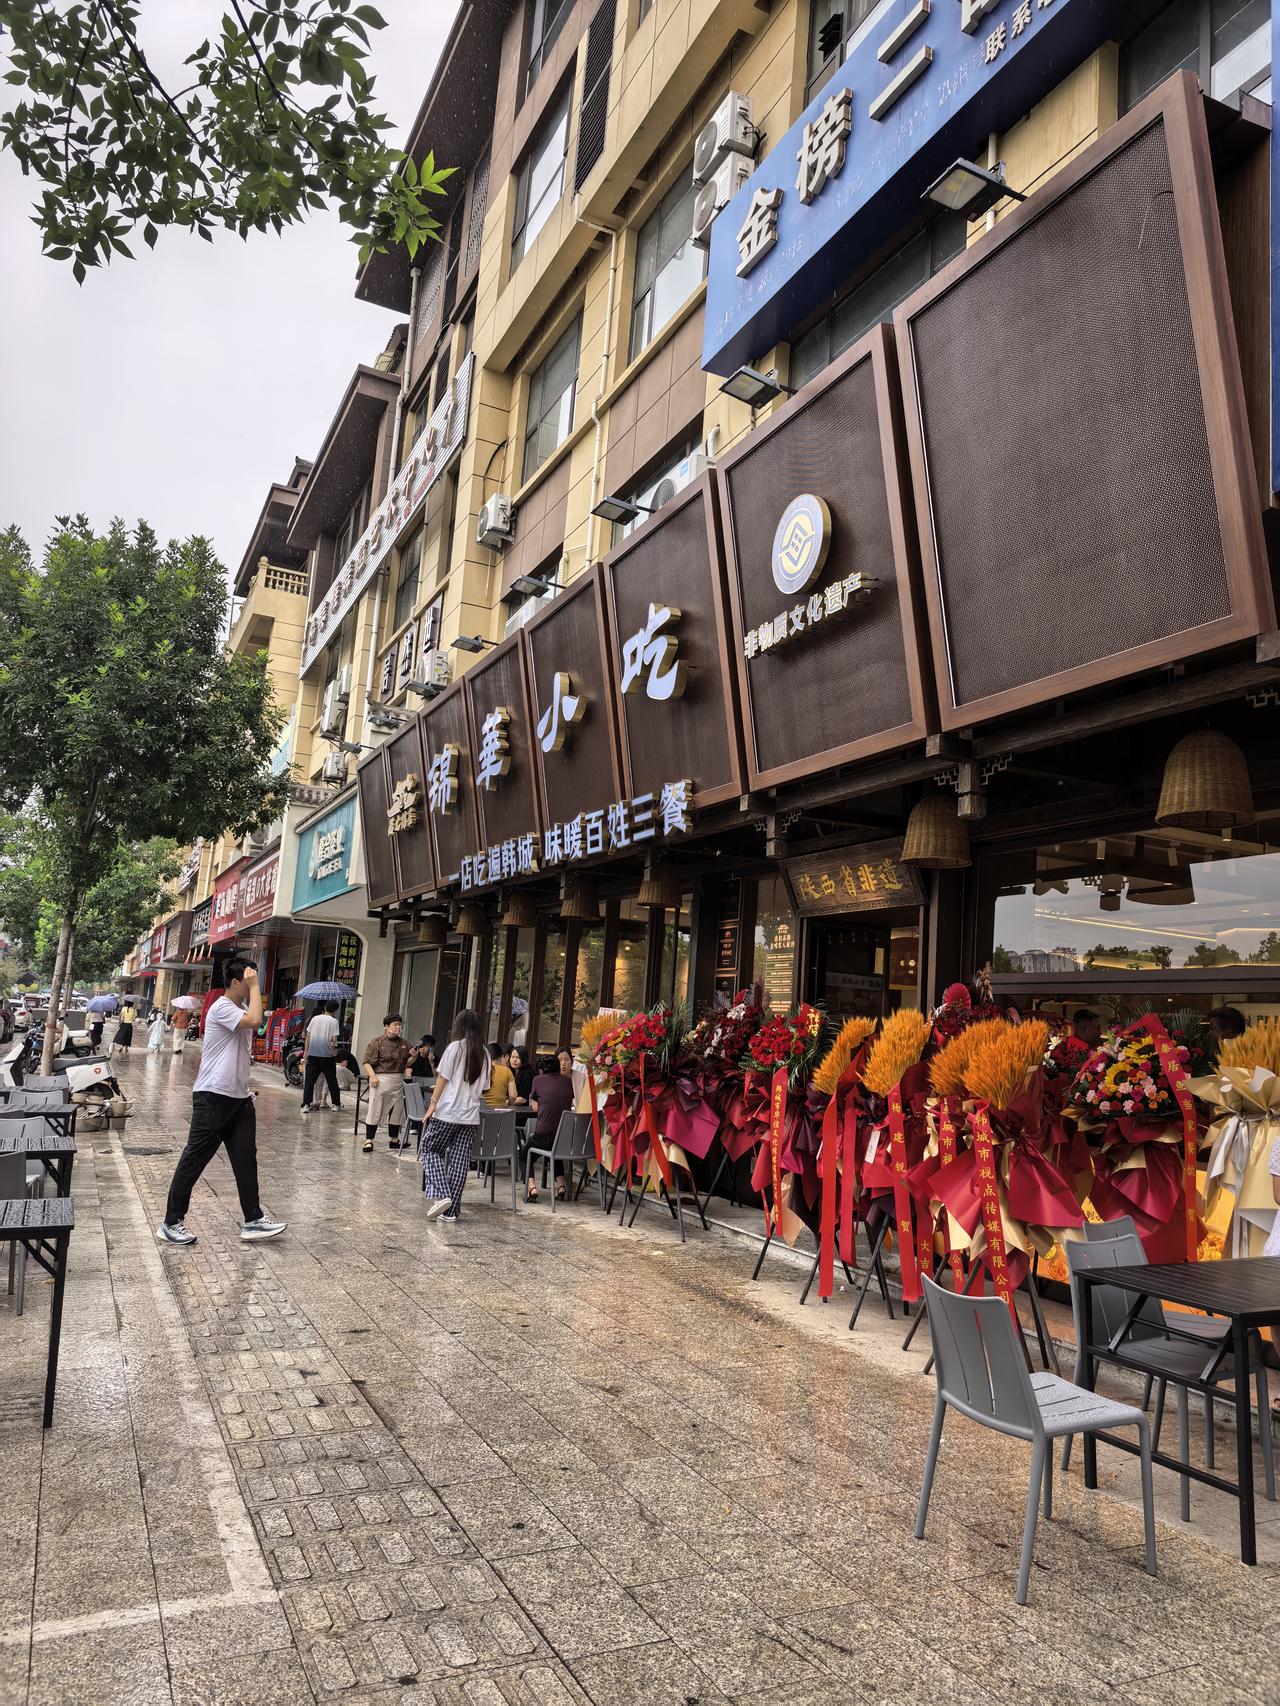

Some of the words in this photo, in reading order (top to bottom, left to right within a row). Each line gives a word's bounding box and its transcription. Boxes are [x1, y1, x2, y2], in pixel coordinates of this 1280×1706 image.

[735, 0, 1008, 279] 金榜二
[743, 571, 862, 659] 非物质文化遗产
[448, 832, 538, 893] 一店吃遍韩城
[544, 779, 690, 864] 味暖百姓三餐
[920, 1240, 930, 1269] 大吉
[975, 1113, 1010, 1304] 韩城市视点传媒有限公司
[952, 1252, 963, 1282] 公司
